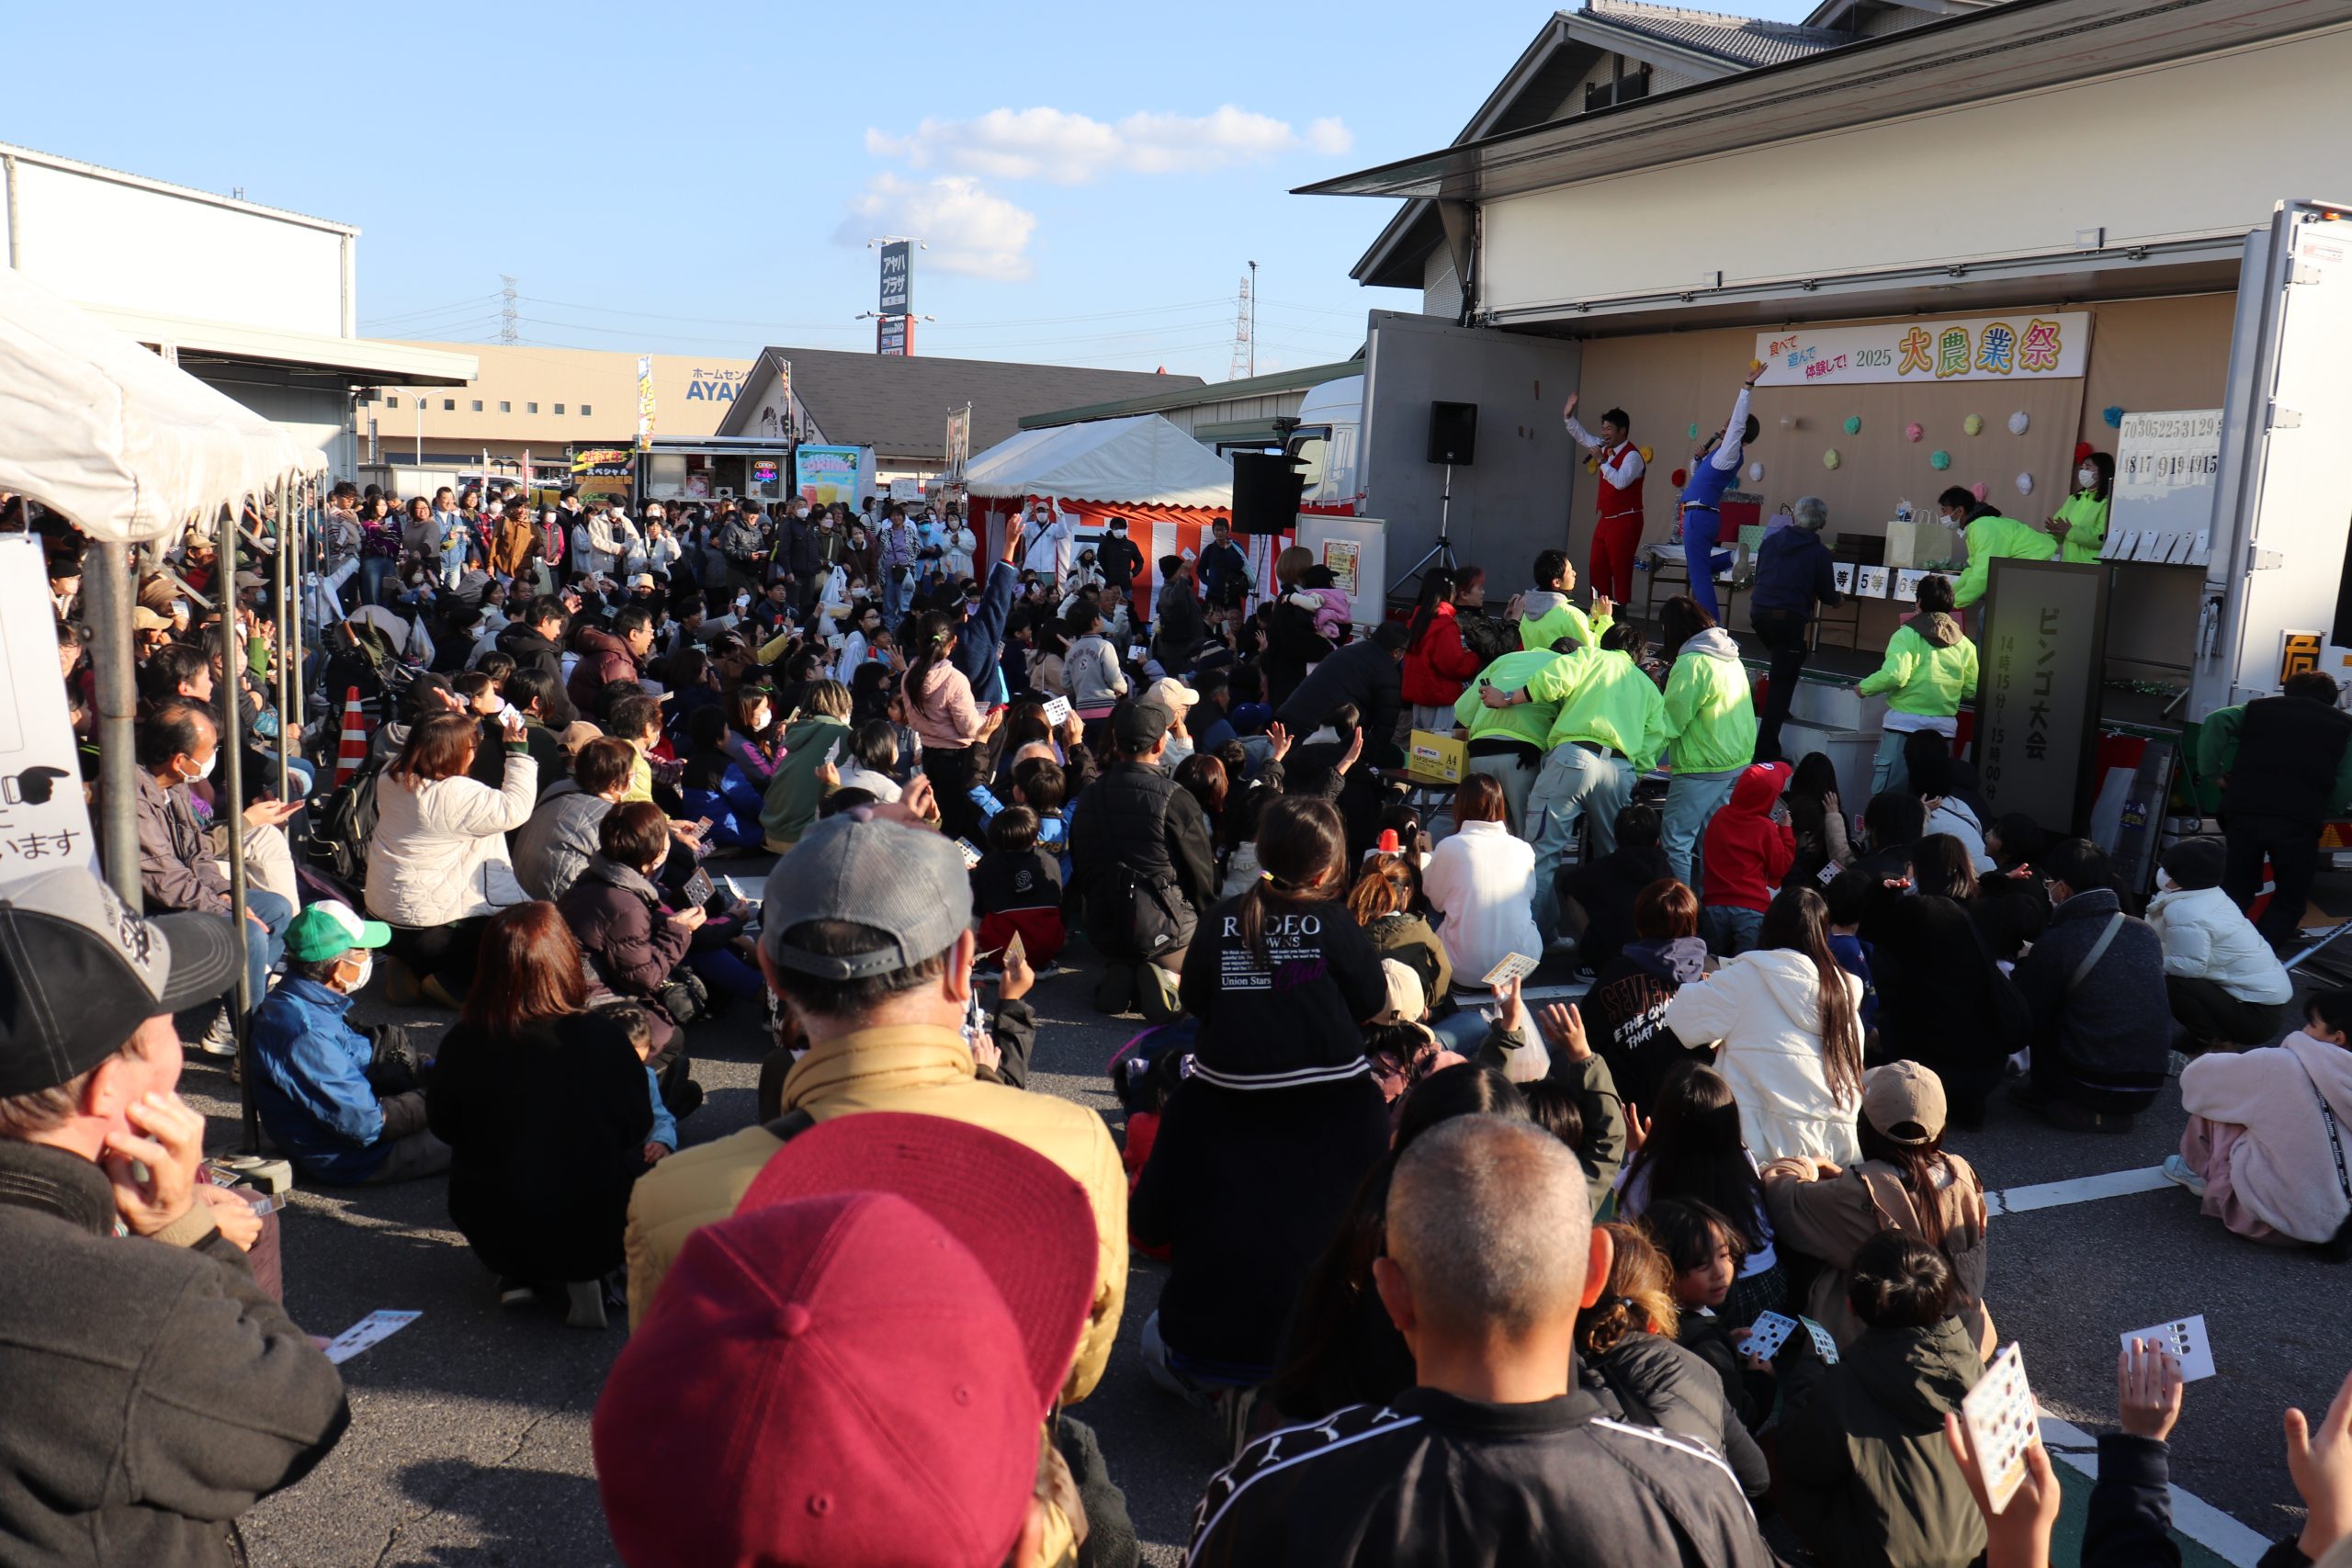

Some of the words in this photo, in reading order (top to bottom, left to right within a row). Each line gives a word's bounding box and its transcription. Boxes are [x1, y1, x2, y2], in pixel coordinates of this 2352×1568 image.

[883, 254, 905, 275] アヤハ
[1769, 335, 1797, 356] 食べて
[1787, 345, 1816, 367] 遊んで
[1856, 349, 1892, 367] 2025
[1899, 321, 2061, 377] 大農業祭
[2203, 456, 2218, 474] 15
[2026, 607, 2059, 761] ビンゴ大会
[1447, 753, 1457, 766] A4
[1221, 914, 1321, 937] RDEO
[1221, 976, 1249, 987] Union
[1250, 976, 1272, 986] Stars
[1623, 1013, 1646, 1035] THE
[1626, 1023, 1655, 1050] THAT
